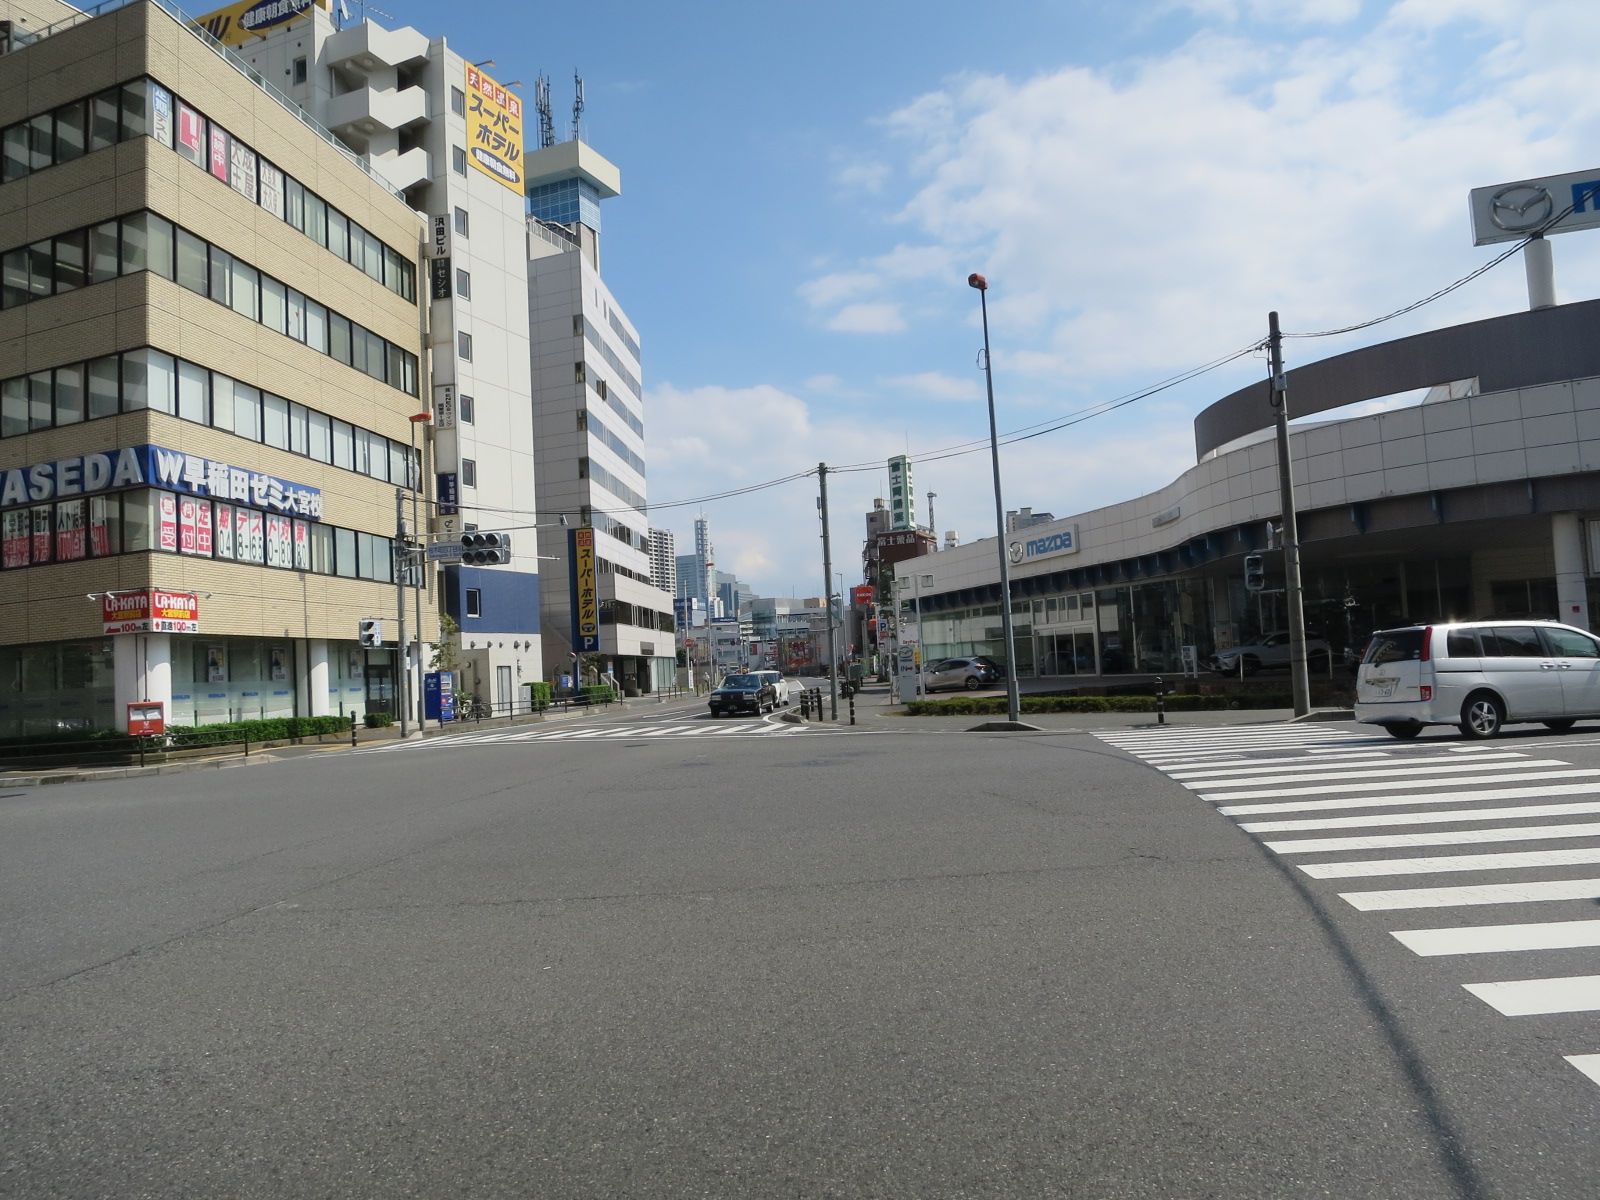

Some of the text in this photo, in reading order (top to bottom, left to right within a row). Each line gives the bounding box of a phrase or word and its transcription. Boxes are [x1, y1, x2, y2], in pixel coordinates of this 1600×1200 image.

[469, 93, 519, 135] スーパー
[476, 122, 520, 161] ホテル
[0, 447, 144, 507] ASEDA
[581, 548, 594, 619] スーパーホテル
[584, 637, 593, 649] P
